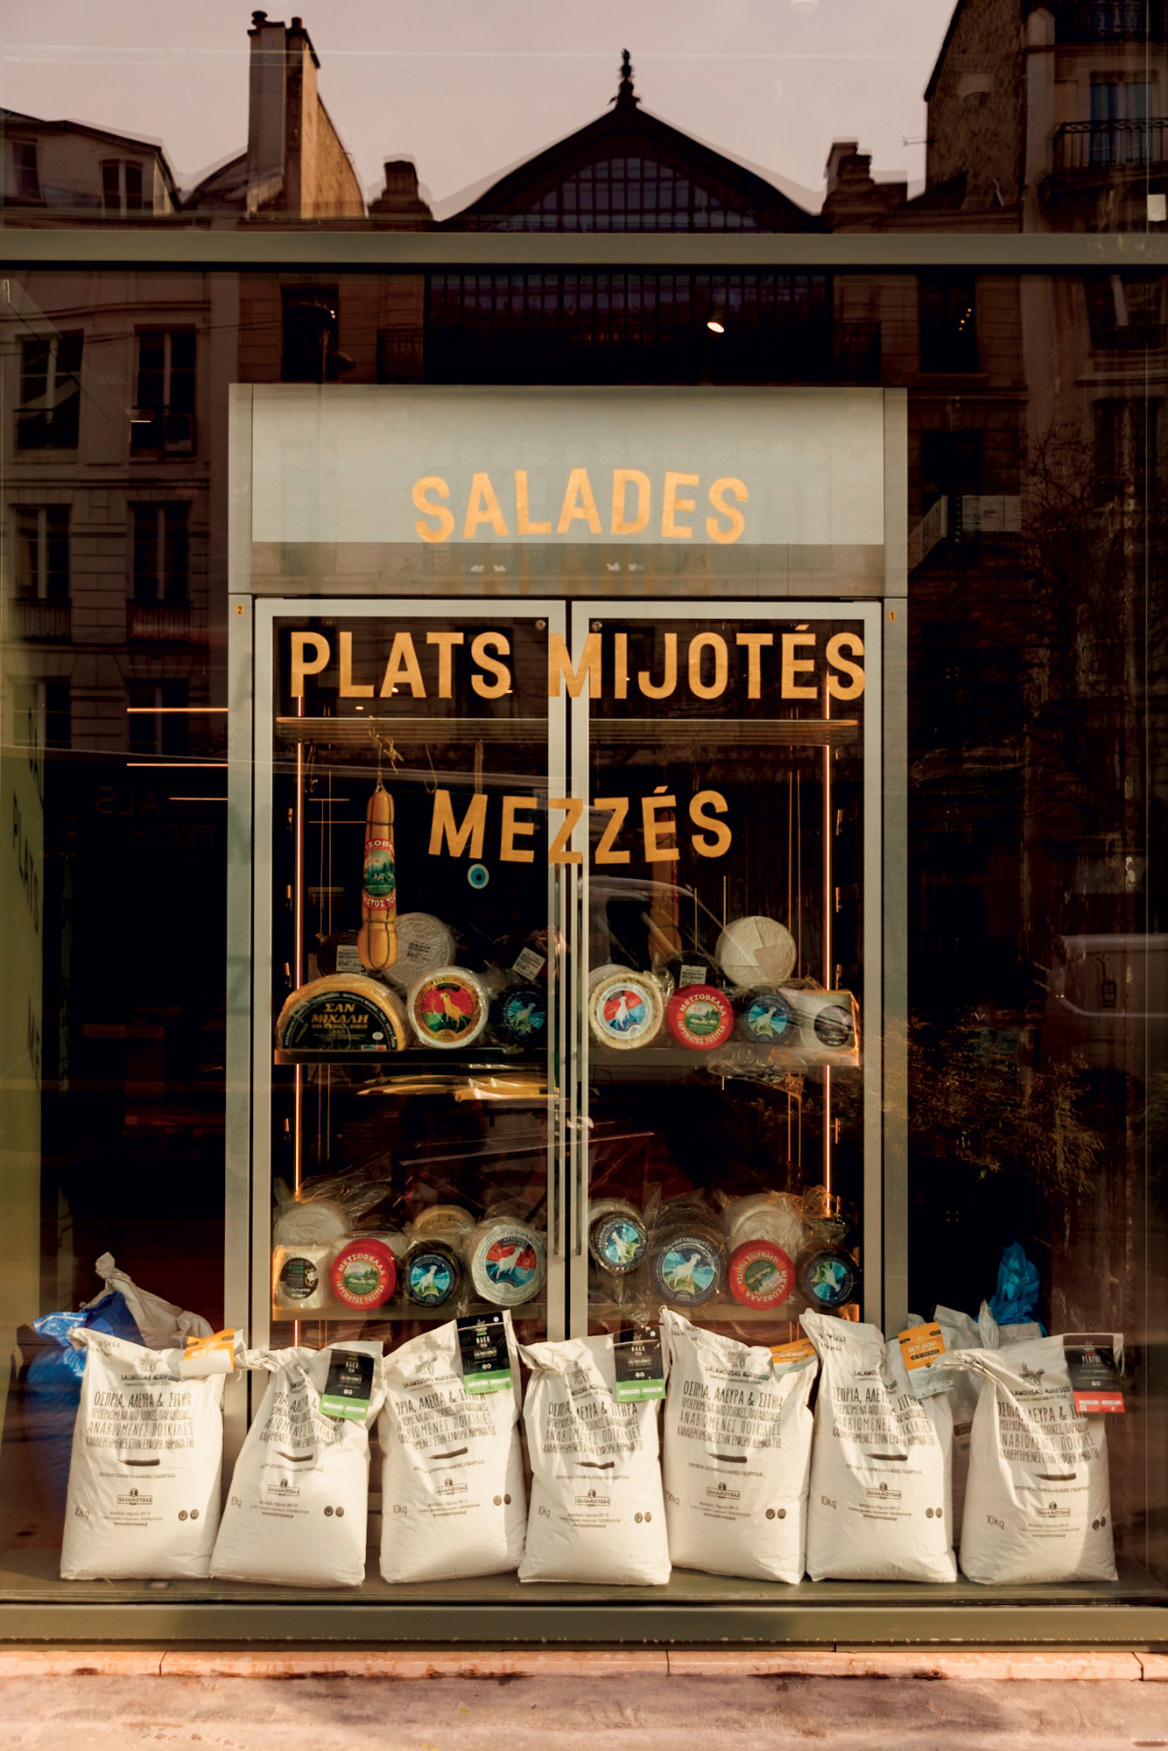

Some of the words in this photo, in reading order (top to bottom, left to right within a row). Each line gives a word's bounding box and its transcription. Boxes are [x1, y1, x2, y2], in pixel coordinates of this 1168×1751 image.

[411, 467, 749, 544] SALADES
[290, 631, 512, 699] PLATS
[549, 624, 866, 701] MIJOTÉS
[428, 785, 733, 864] MEZZÉS
[713, 1387, 744, 1405] ΑΛΕΥΡΑ
[747, 1391, 755, 1406] &
[601, 1401, 608, 1414] &
[1059, 1405, 1068, 1420] &
[895, 1420, 933, 1436] ΟΙΚΙΛΙΕΣ
[392, 1504, 408, 1515] 10kg
[821, 1495, 837, 1509] 10kg
[986, 1513, 1005, 1530] 10kg
